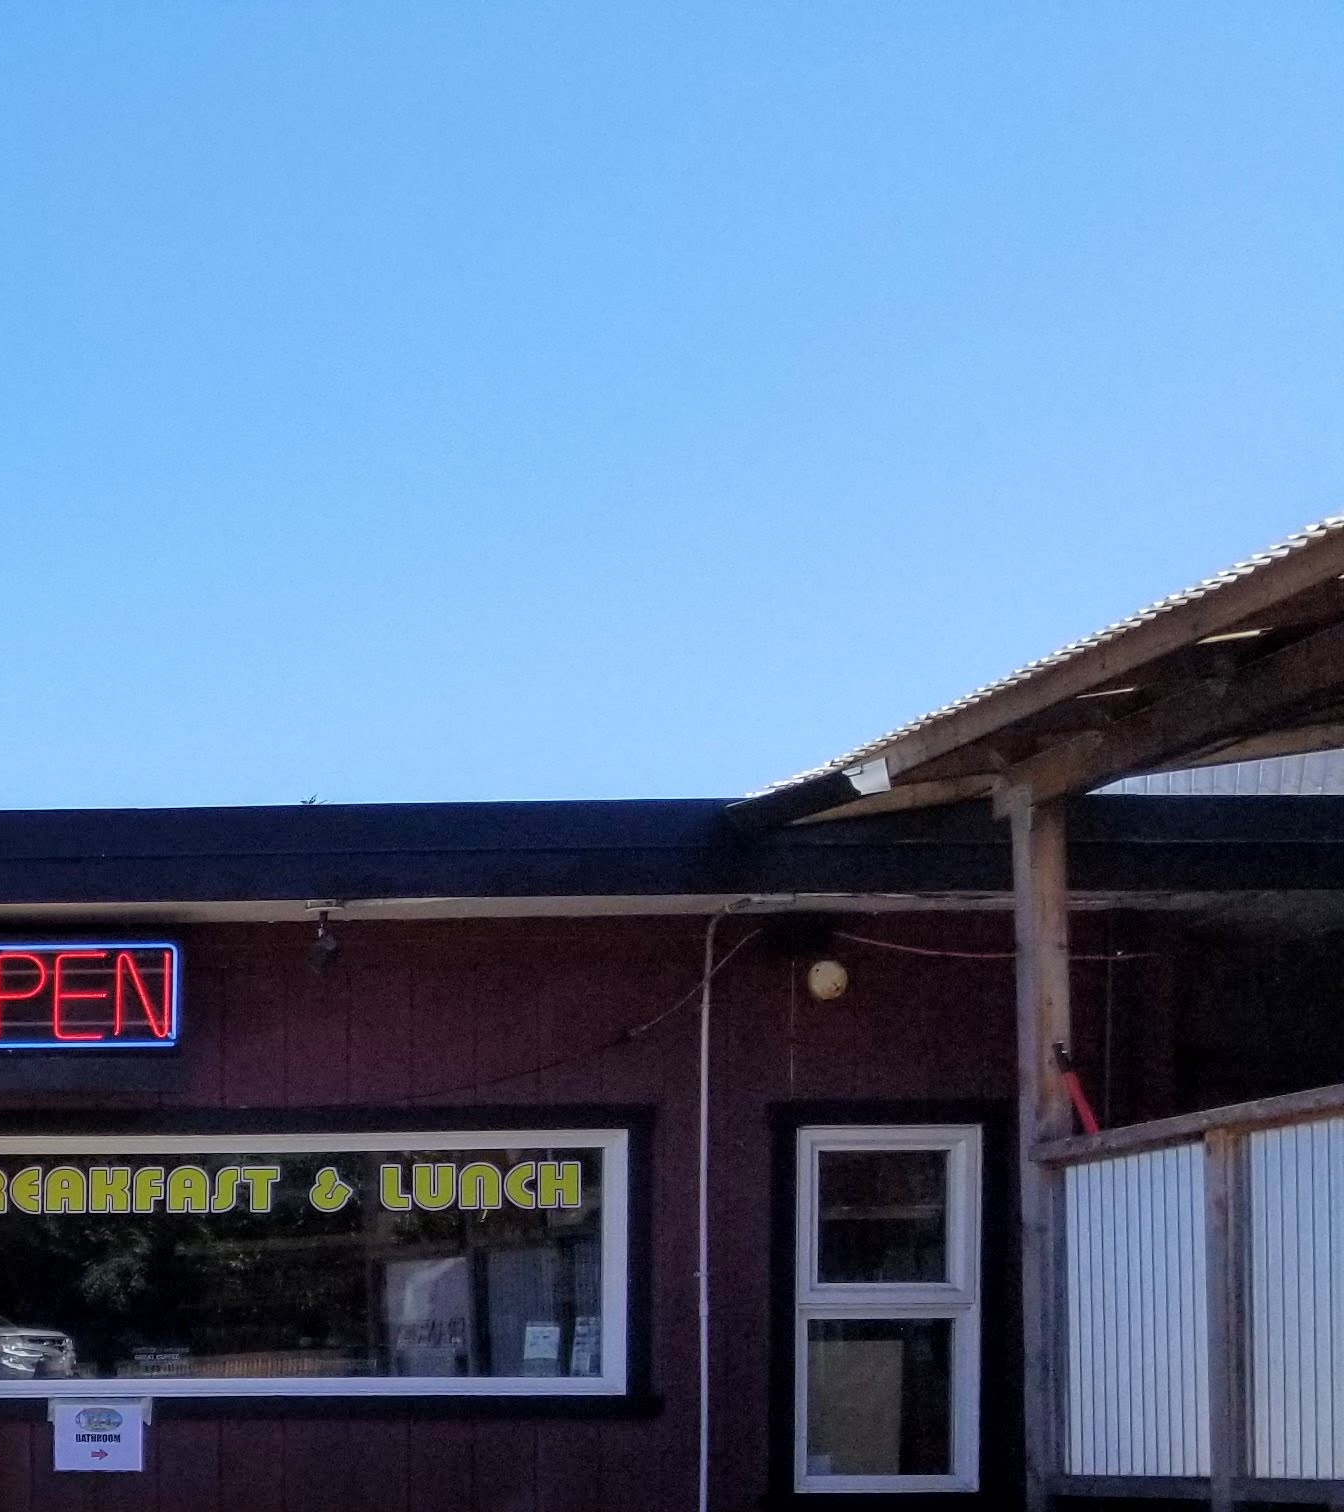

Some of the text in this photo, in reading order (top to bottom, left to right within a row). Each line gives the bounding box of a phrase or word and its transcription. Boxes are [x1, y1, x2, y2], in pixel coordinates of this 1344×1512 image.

[308, 1167, 354, 1211] &
[379, 1160, 582, 1210] LUNCH
[75, 1433, 121, 1443] BATHROOM
